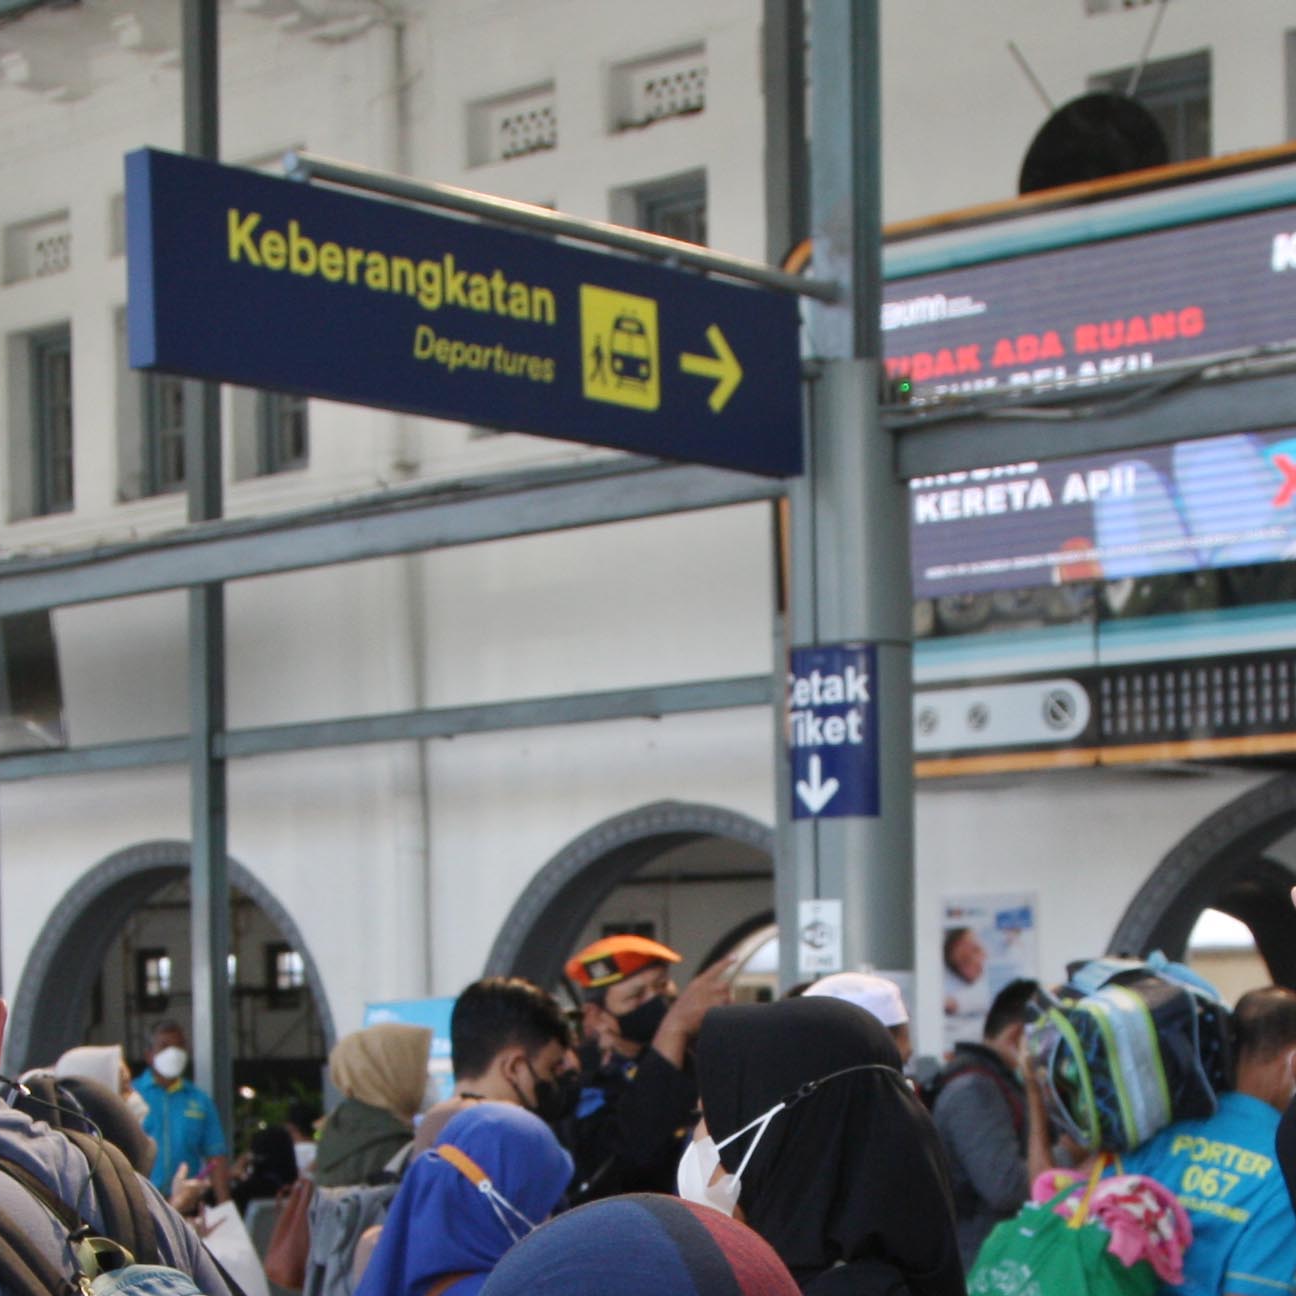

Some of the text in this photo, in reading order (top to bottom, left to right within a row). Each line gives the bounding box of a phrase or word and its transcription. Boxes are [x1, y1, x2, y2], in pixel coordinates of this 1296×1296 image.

[227, 207, 556, 325] Keberangkatan
[412, 324, 556, 383] Departures
[990, 332, 1065, 369] ADA
[1074, 306, 1206, 355] RUANG
[914, 476, 1053, 524] KERETA
[1170, 1133, 1274, 1179] PORTER
[1181, 1163, 1241, 1200] 067
